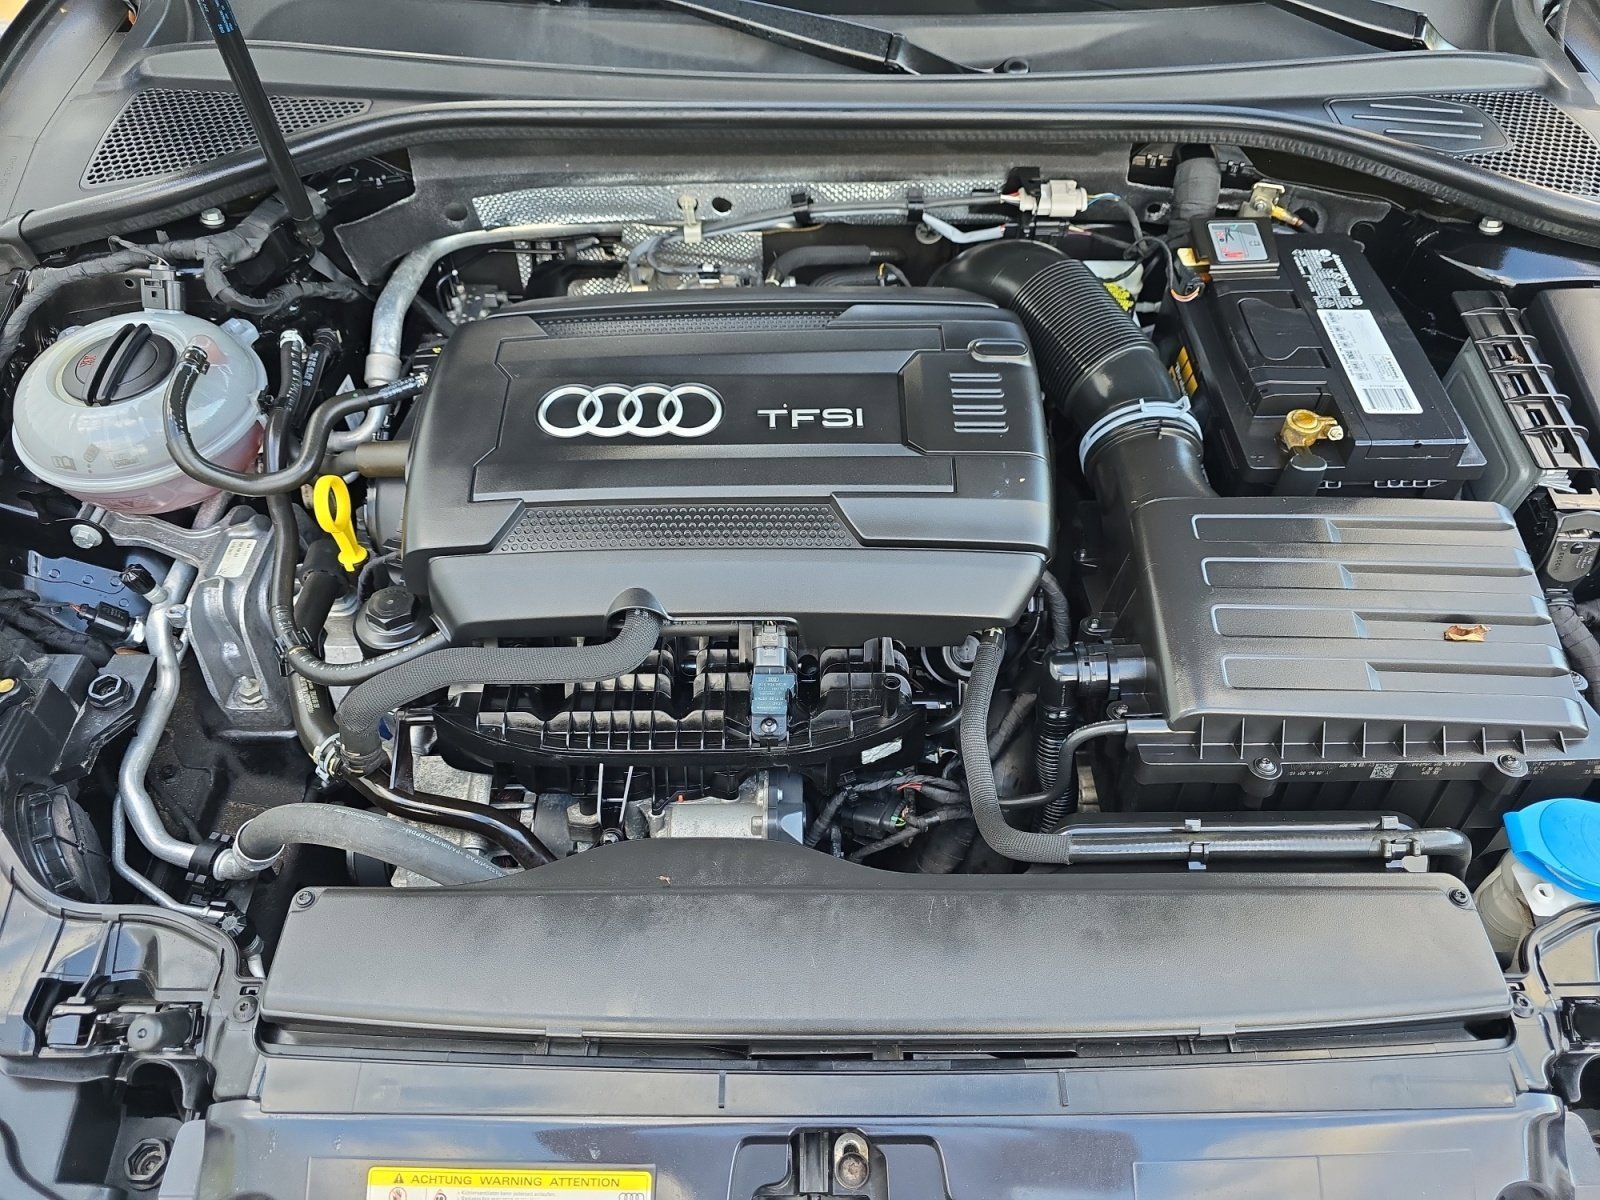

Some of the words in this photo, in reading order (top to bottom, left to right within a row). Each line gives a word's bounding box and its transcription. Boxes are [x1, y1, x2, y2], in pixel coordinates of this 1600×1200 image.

[757, 407, 864, 430] TFSI
[411, 1174, 473, 1185] ACHTUNG
[479, 1176, 543, 1187] WARNING
[549, 1177, 621, 1188] ATTENTION
